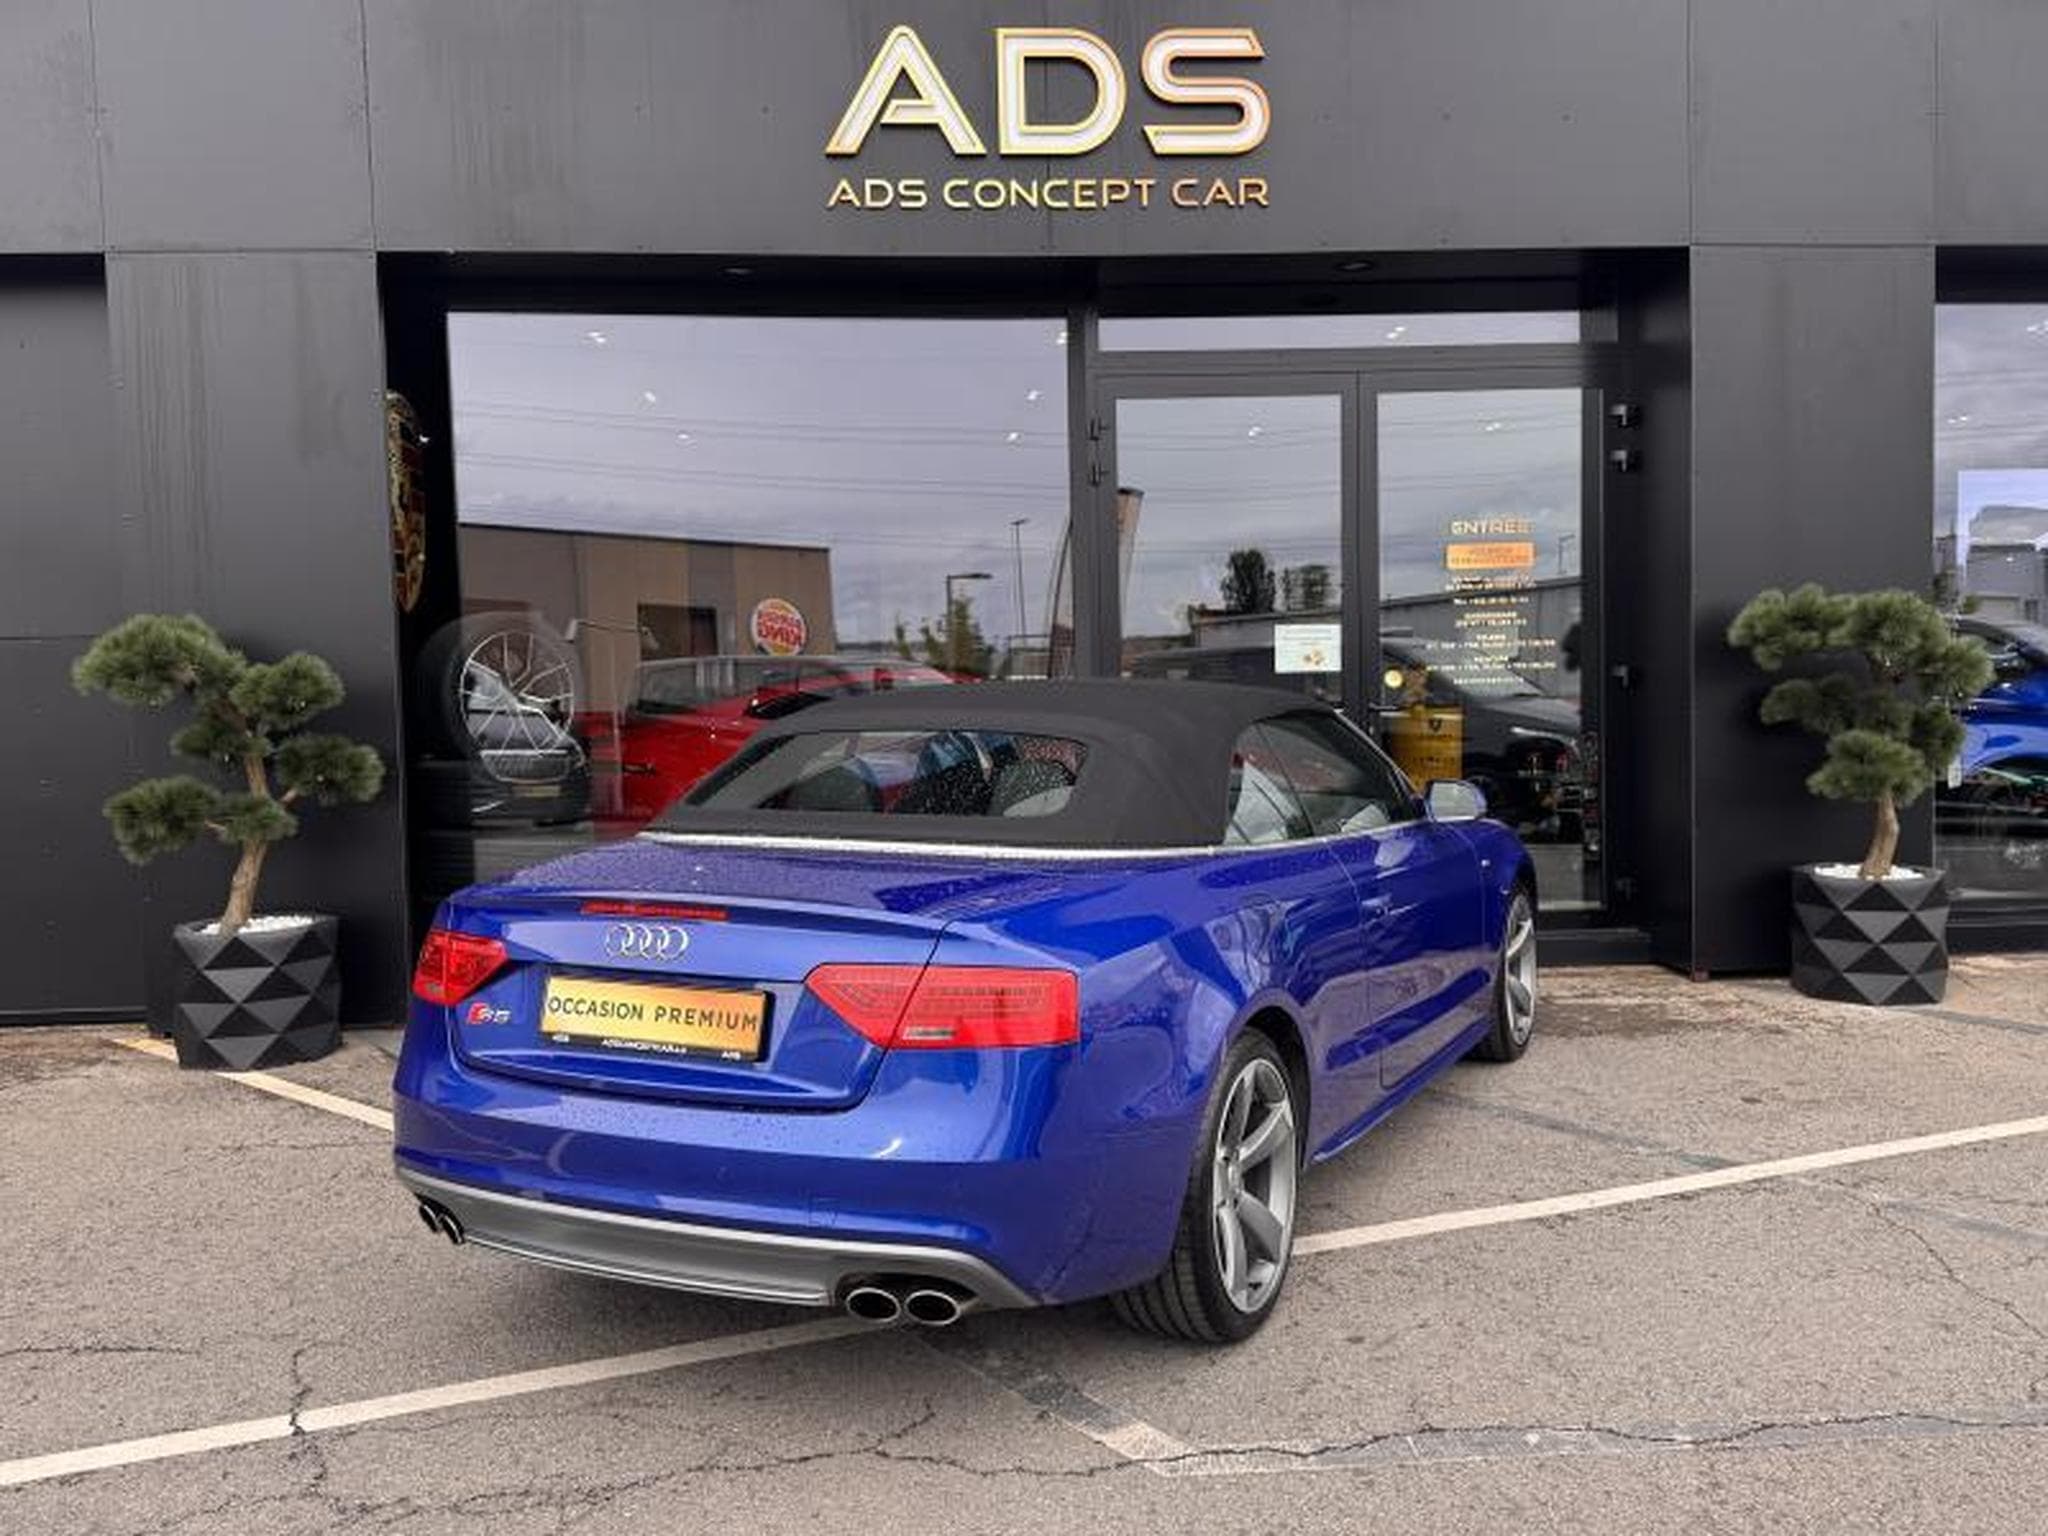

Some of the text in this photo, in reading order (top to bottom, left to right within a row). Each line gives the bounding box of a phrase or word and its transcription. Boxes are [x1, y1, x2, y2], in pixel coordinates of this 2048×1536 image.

[826, 25, 1271, 156] ADS
[827, 178, 1270, 210] ADS CONCEPT CAR
[548, 994, 757, 1032] OCCASION PREMIUM
